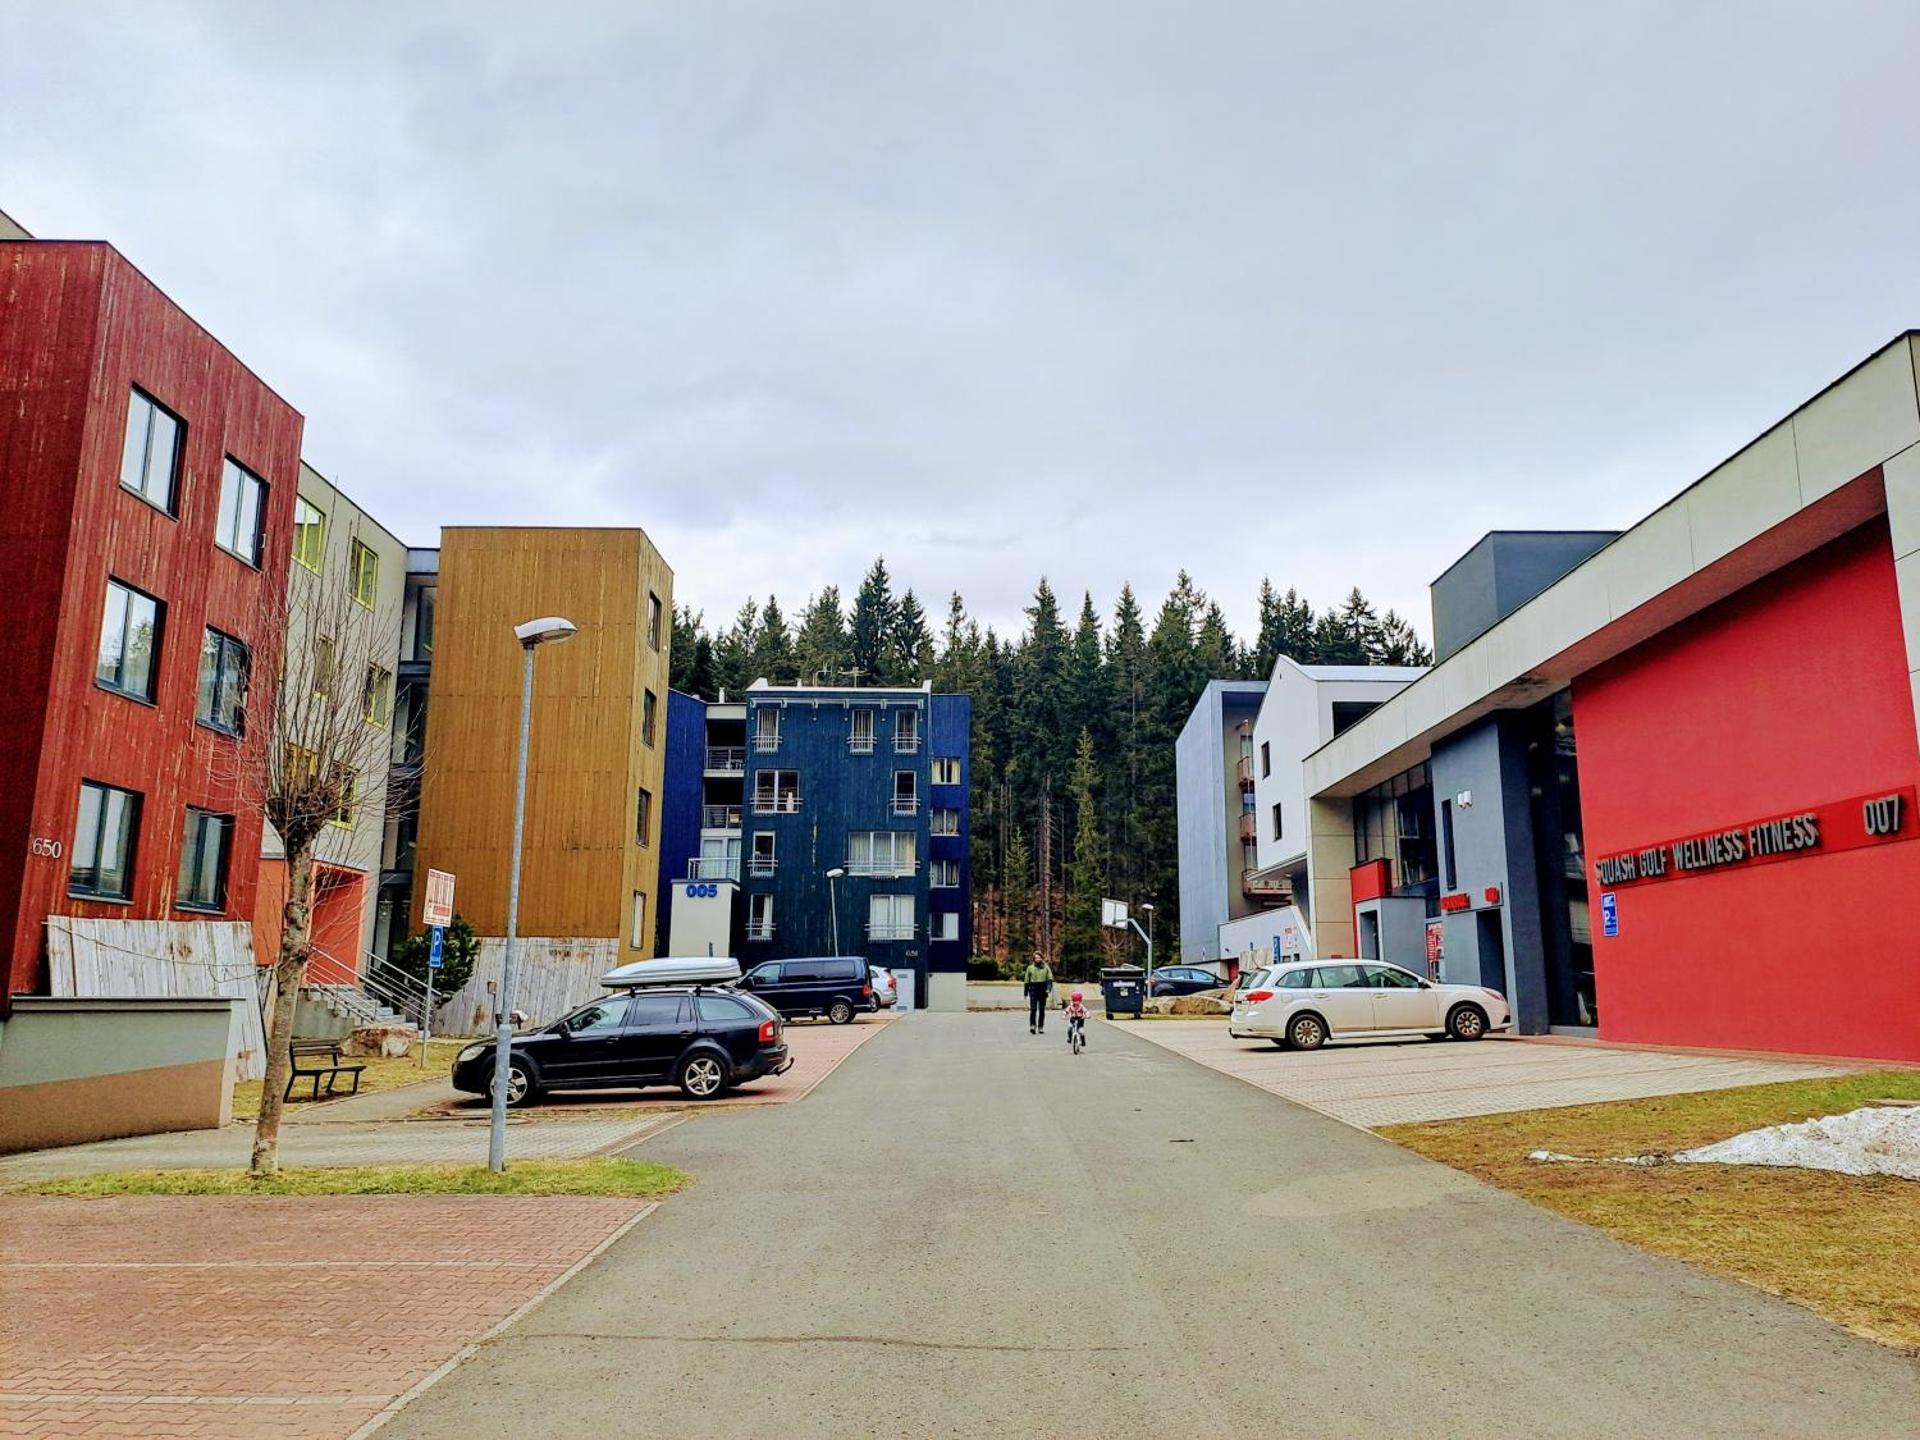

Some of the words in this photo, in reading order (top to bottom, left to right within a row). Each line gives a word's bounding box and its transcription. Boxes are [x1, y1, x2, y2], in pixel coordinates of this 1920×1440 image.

[32, 837, 62, 858] 650
[1594, 853, 1635, 886] SQUASH
[1640, 846, 1666, 877] GOLF
[1672, 829, 1745, 870] WELLNESS
[1748, 812, 1819, 856] FITNESS
[1863, 793, 1898, 835] 007
[686, 884, 718, 898] 005
[433, 930, 441, 954] P
